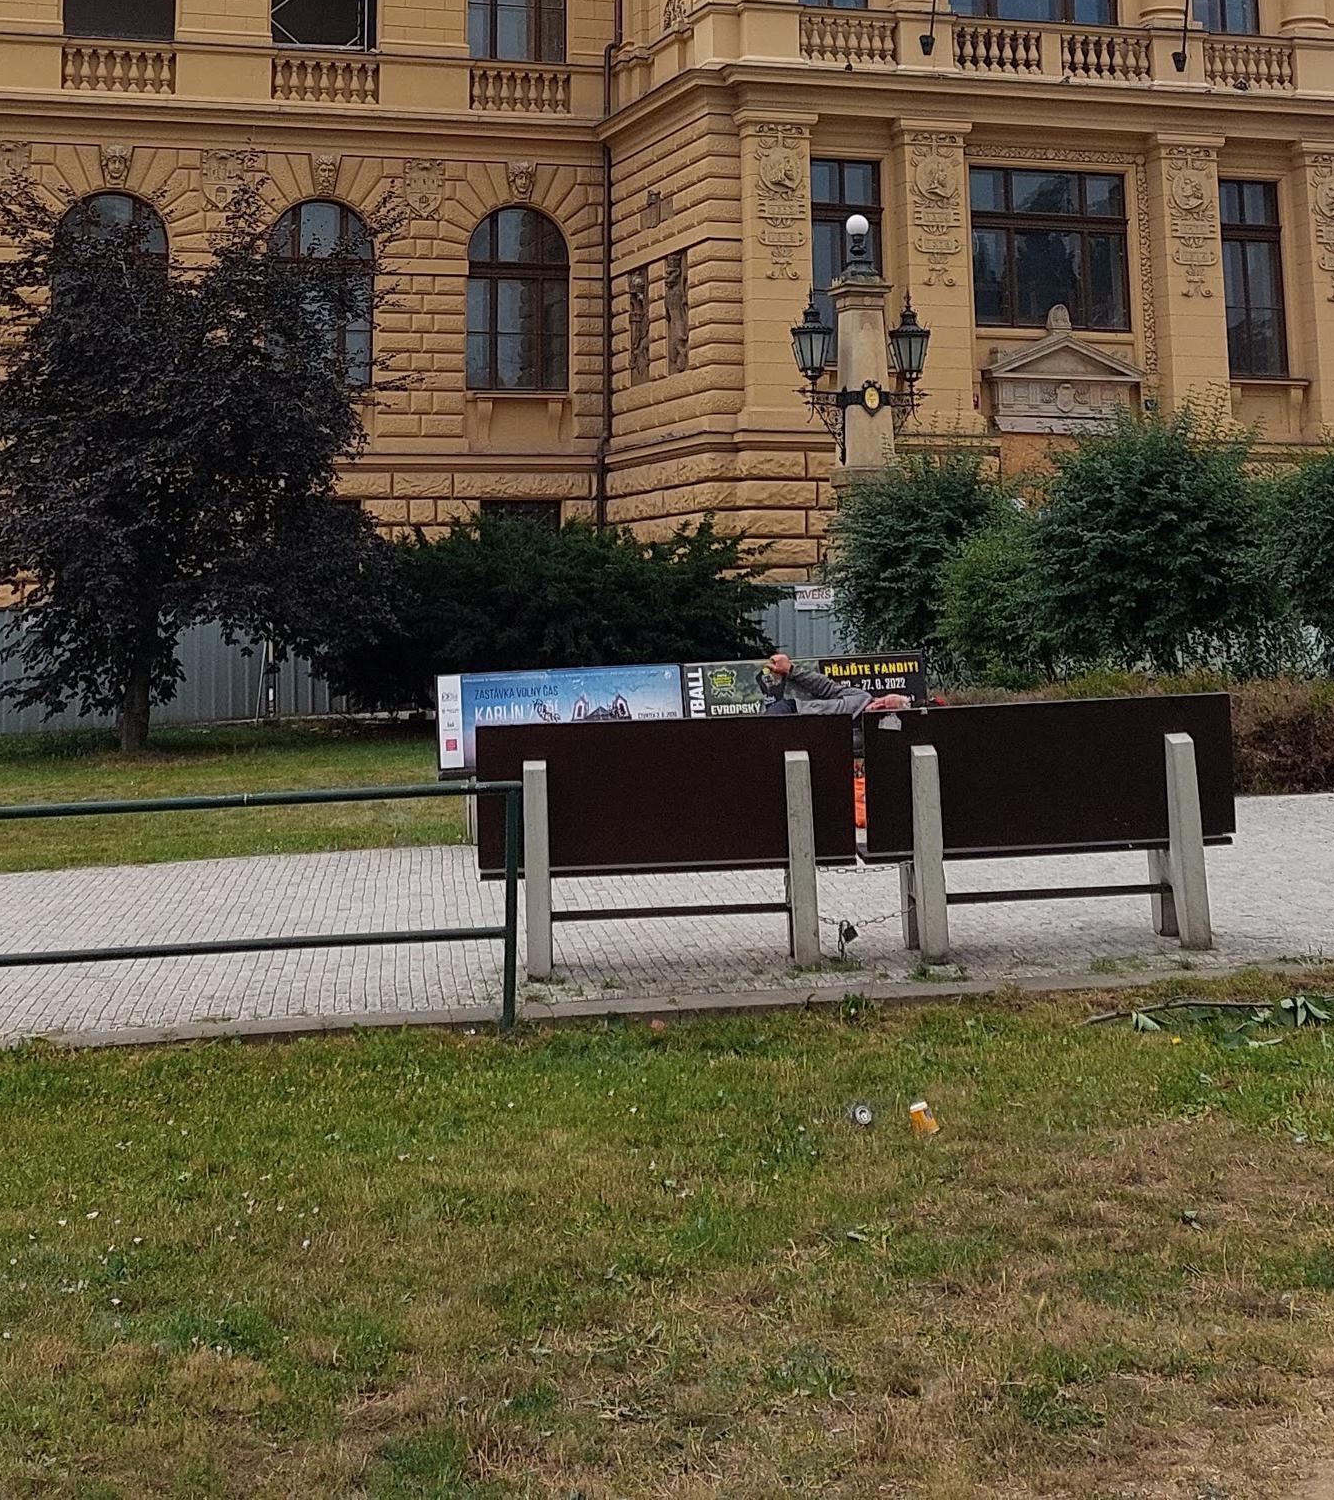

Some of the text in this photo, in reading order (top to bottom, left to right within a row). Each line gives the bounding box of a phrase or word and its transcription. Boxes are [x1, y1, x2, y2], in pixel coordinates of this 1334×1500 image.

[824, 660, 920, 677] PŘIJĎTE FANDIT!
[885, 677, 907, 690] 2022
[710, 700, 761, 715] EVROPSKÝ
